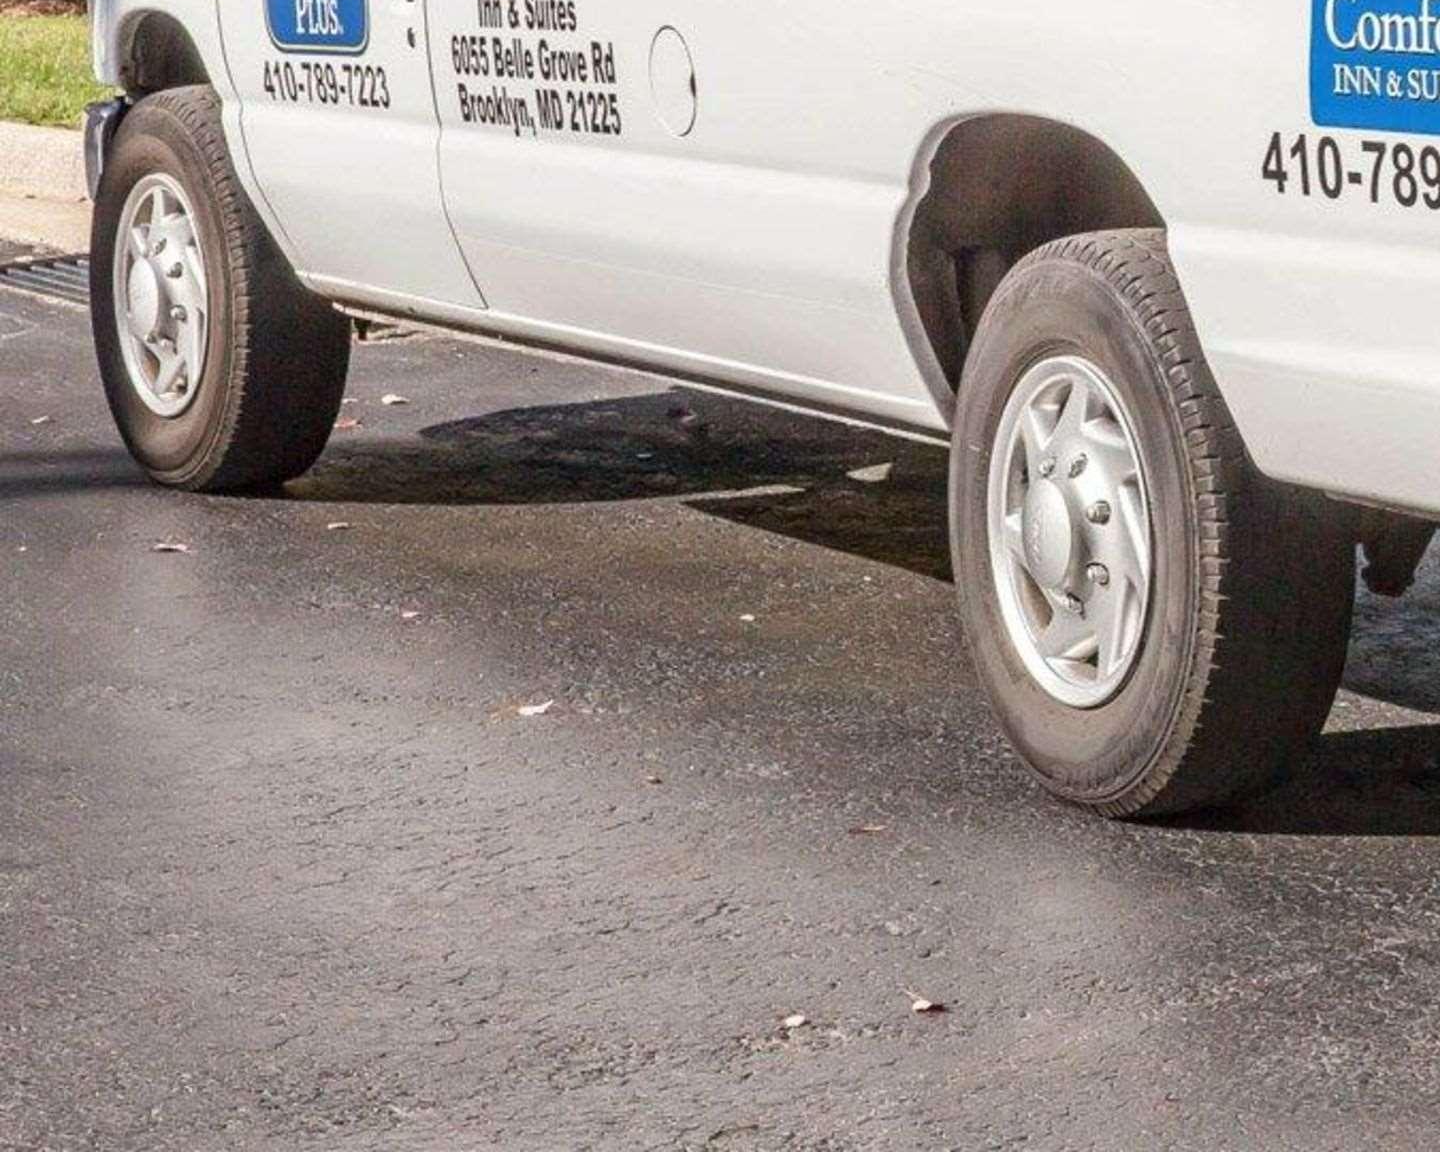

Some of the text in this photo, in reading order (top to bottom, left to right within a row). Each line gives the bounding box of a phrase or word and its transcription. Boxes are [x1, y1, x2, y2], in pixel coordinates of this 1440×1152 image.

[451, 35, 616, 84] 6055 Belle Grove Rd
[1333, 63, 1382, 97] INN
[1387, 70, 1402, 98] &
[263, 60, 391, 110] 410-789-7223
[458, 82, 622, 139] Brooklyn, MD 21225
